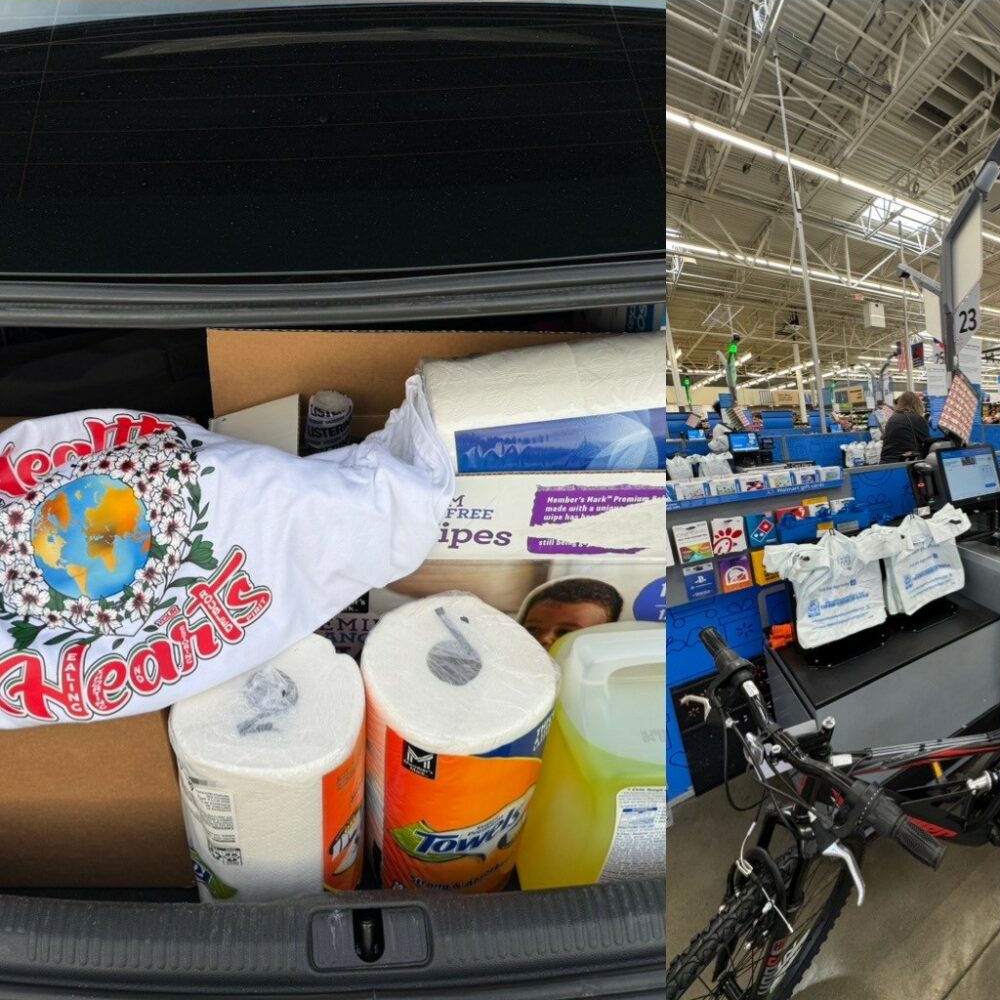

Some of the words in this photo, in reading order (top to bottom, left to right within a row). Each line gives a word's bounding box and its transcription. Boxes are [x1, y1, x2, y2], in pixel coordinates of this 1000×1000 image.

[959, 308, 977, 333] 23
[446, 508, 494, 520] FREE
[438, 521, 512, 549] ipes
[64, 652, 82, 713] EALING
[415, 808, 520, 856] Towels
